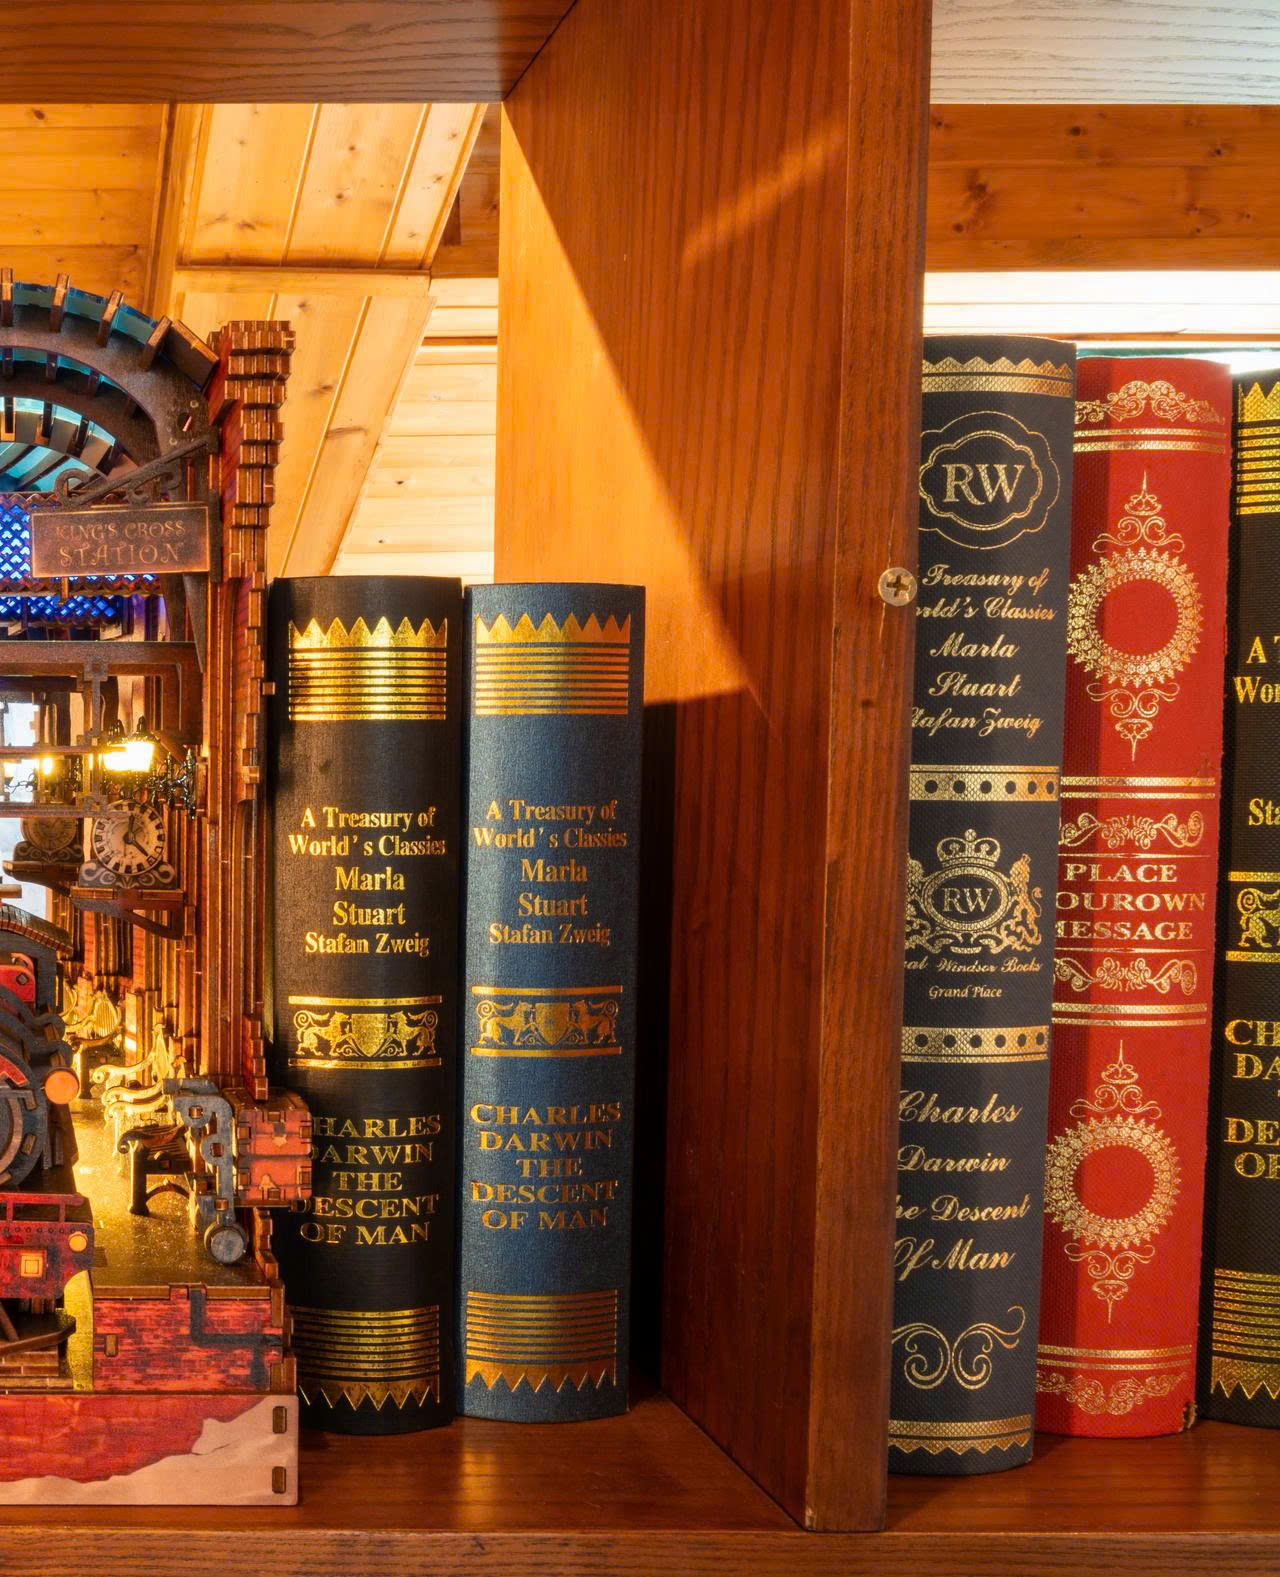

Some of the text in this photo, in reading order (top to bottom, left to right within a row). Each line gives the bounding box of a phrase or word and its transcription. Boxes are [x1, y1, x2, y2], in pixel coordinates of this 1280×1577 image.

[942, 464, 1025, 505] RW
[56, 520, 185, 542] KING'S CROSS
[59, 542, 184, 567] STATION
[922, 564, 1050, 595] Treasury of
[930, 632, 1020, 657] Marla
[1246, 635, 1268, 664] A
[928, 672, 1022, 696] Stuart
[979, 707, 1045, 738] Zweig
[301, 806, 436, 833] A Treasury of
[486, 799, 618, 825] A Treasury of
[378, 835, 446, 857] Classies
[563, 827, 628, 849] Classies
[335, 867, 405, 891] Marla
[520, 858, 588, 882] Marla
[1064, 863, 1178, 883] PLACE
[517, 892, 588, 916] Stuart
[941, 887, 994, 914] RW
[332, 901, 406, 926] Stuart
[305, 932, 430, 958] Stafan Zweig
[488, 922, 611, 947] Stafan Zweig
[937, 957, 998, 972] Windsor
[1000, 957, 1043, 973] Books
[928, 984, 1004, 999] Grand Place
[470, 1102, 621, 1125] CHARLES
[899, 1090, 1023, 1123] Charles
[312, 1114, 441, 1138] HARLES
[479, 1129, 613, 1152] DARWIN
[516, 1156, 584, 1177] THE
[897, 1144, 1012, 1172] Darwin
[332, 1171, 403, 1192] THE
[470, 1180, 619, 1204] DESCENT
[481, 1206, 609, 1231] OF MAN
[931, 1193, 1032, 1222] Descent
[300, 1222, 430, 1245] OF MAN
[931, 1238, 1017, 1270] Man
